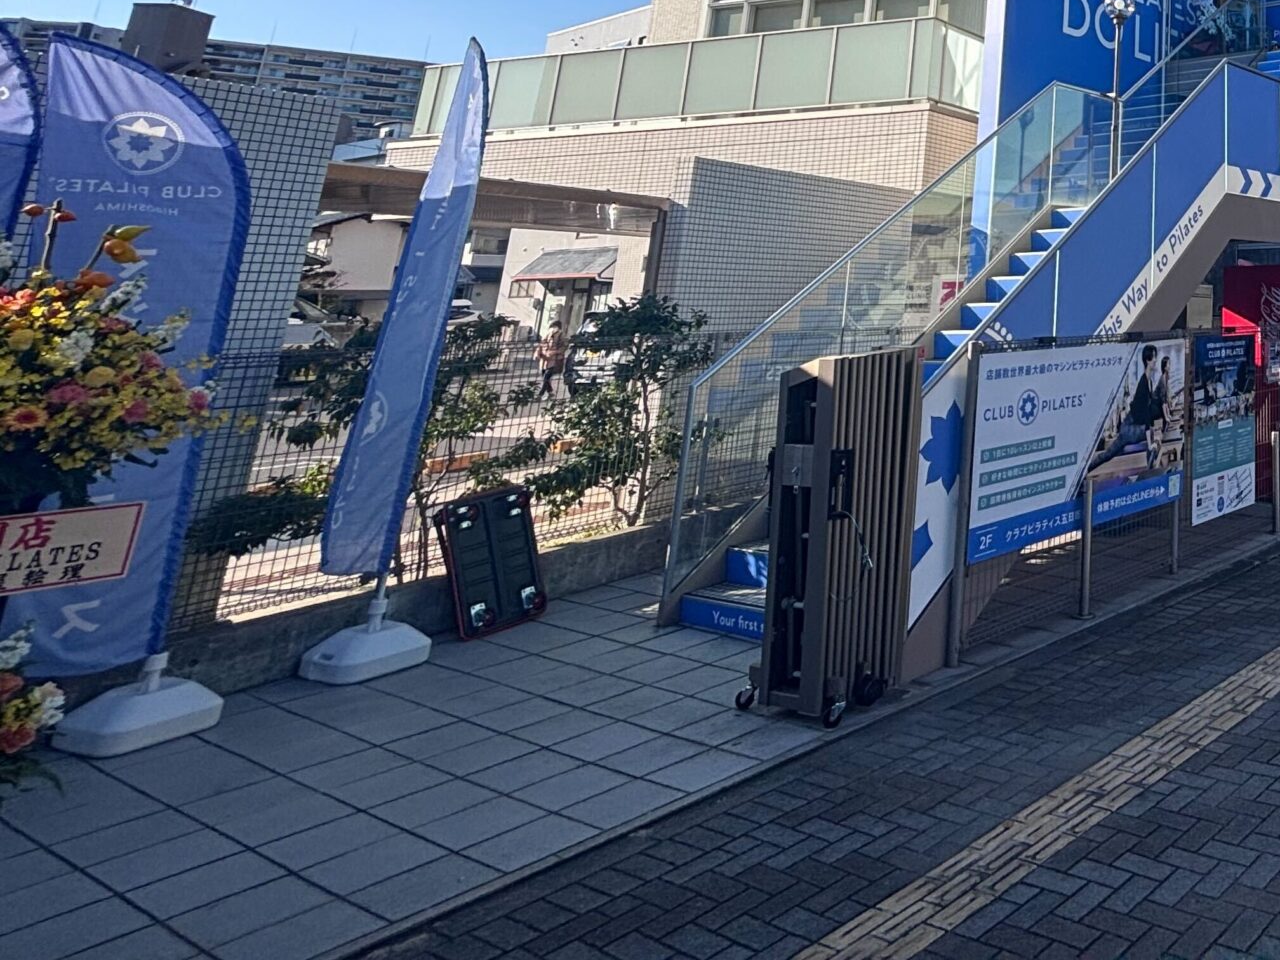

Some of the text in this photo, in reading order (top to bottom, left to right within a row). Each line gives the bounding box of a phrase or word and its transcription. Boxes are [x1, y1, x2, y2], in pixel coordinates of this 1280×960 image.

[1121, 278, 1150, 316] Way
[1155, 252, 1169, 273] to
[1169, 204, 1205, 255] Pilates
[983, 394, 1084, 422] CLUB PILATES
[979, 534, 993, 550] 2F
[712, 610, 736, 628] Your
[738, 615, 758, 632] first
